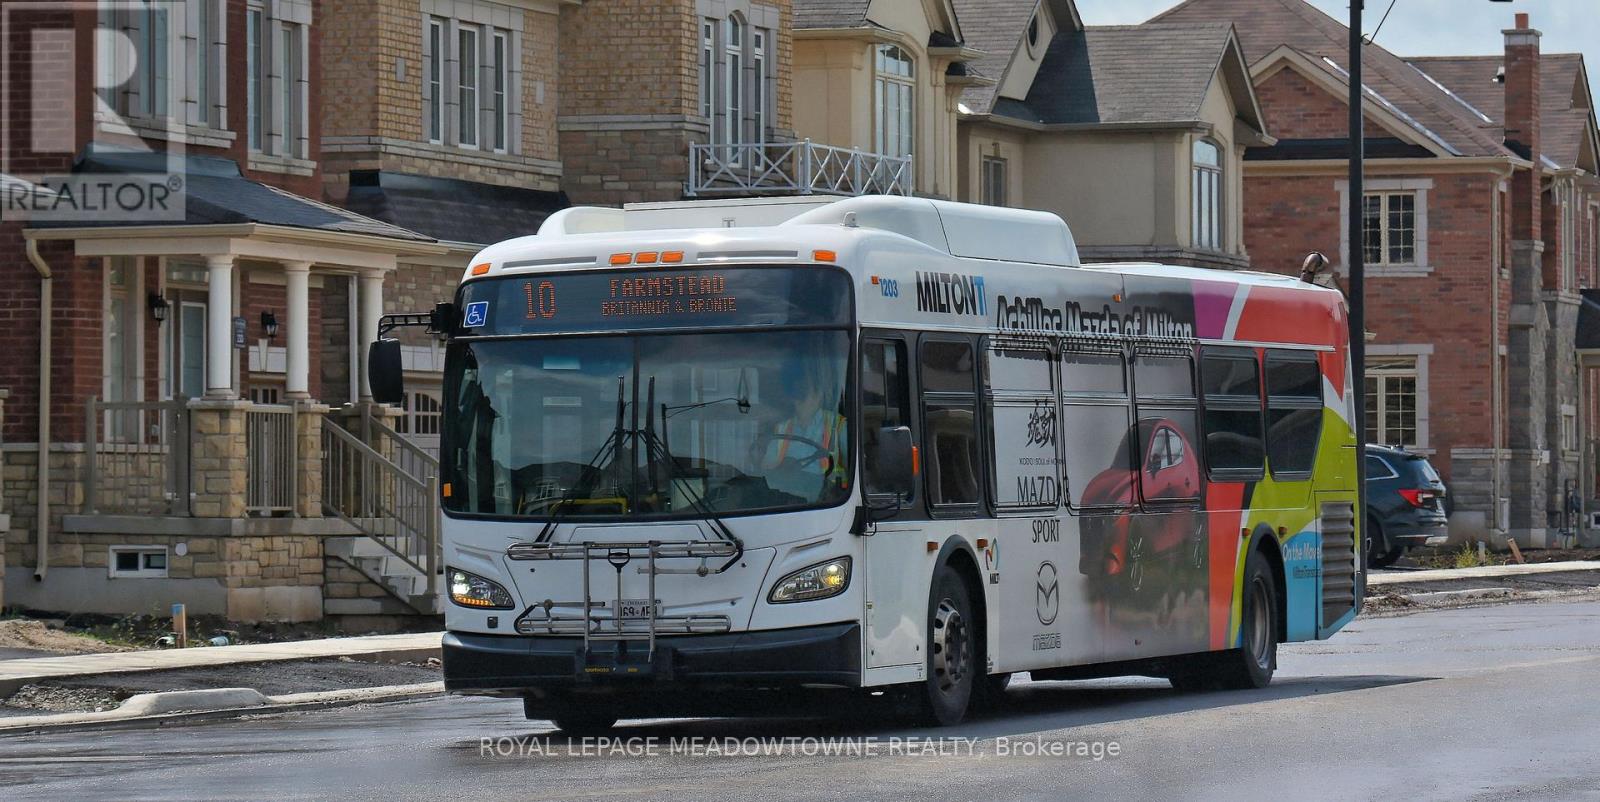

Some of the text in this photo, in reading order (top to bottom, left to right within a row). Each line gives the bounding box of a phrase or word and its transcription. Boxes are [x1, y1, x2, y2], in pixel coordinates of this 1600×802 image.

[610, 275, 725, 298] FARMSTEAD
[879, 279, 899, 298] 1203
[523, 280, 557, 319] 10
[602, 297, 737, 316] BRITANNIA & BRONTE
[1065, 301, 1121, 352] Mazda
[1143, 307, 1195, 354] Milton
[1032, 519, 1061, 543] SPORT
